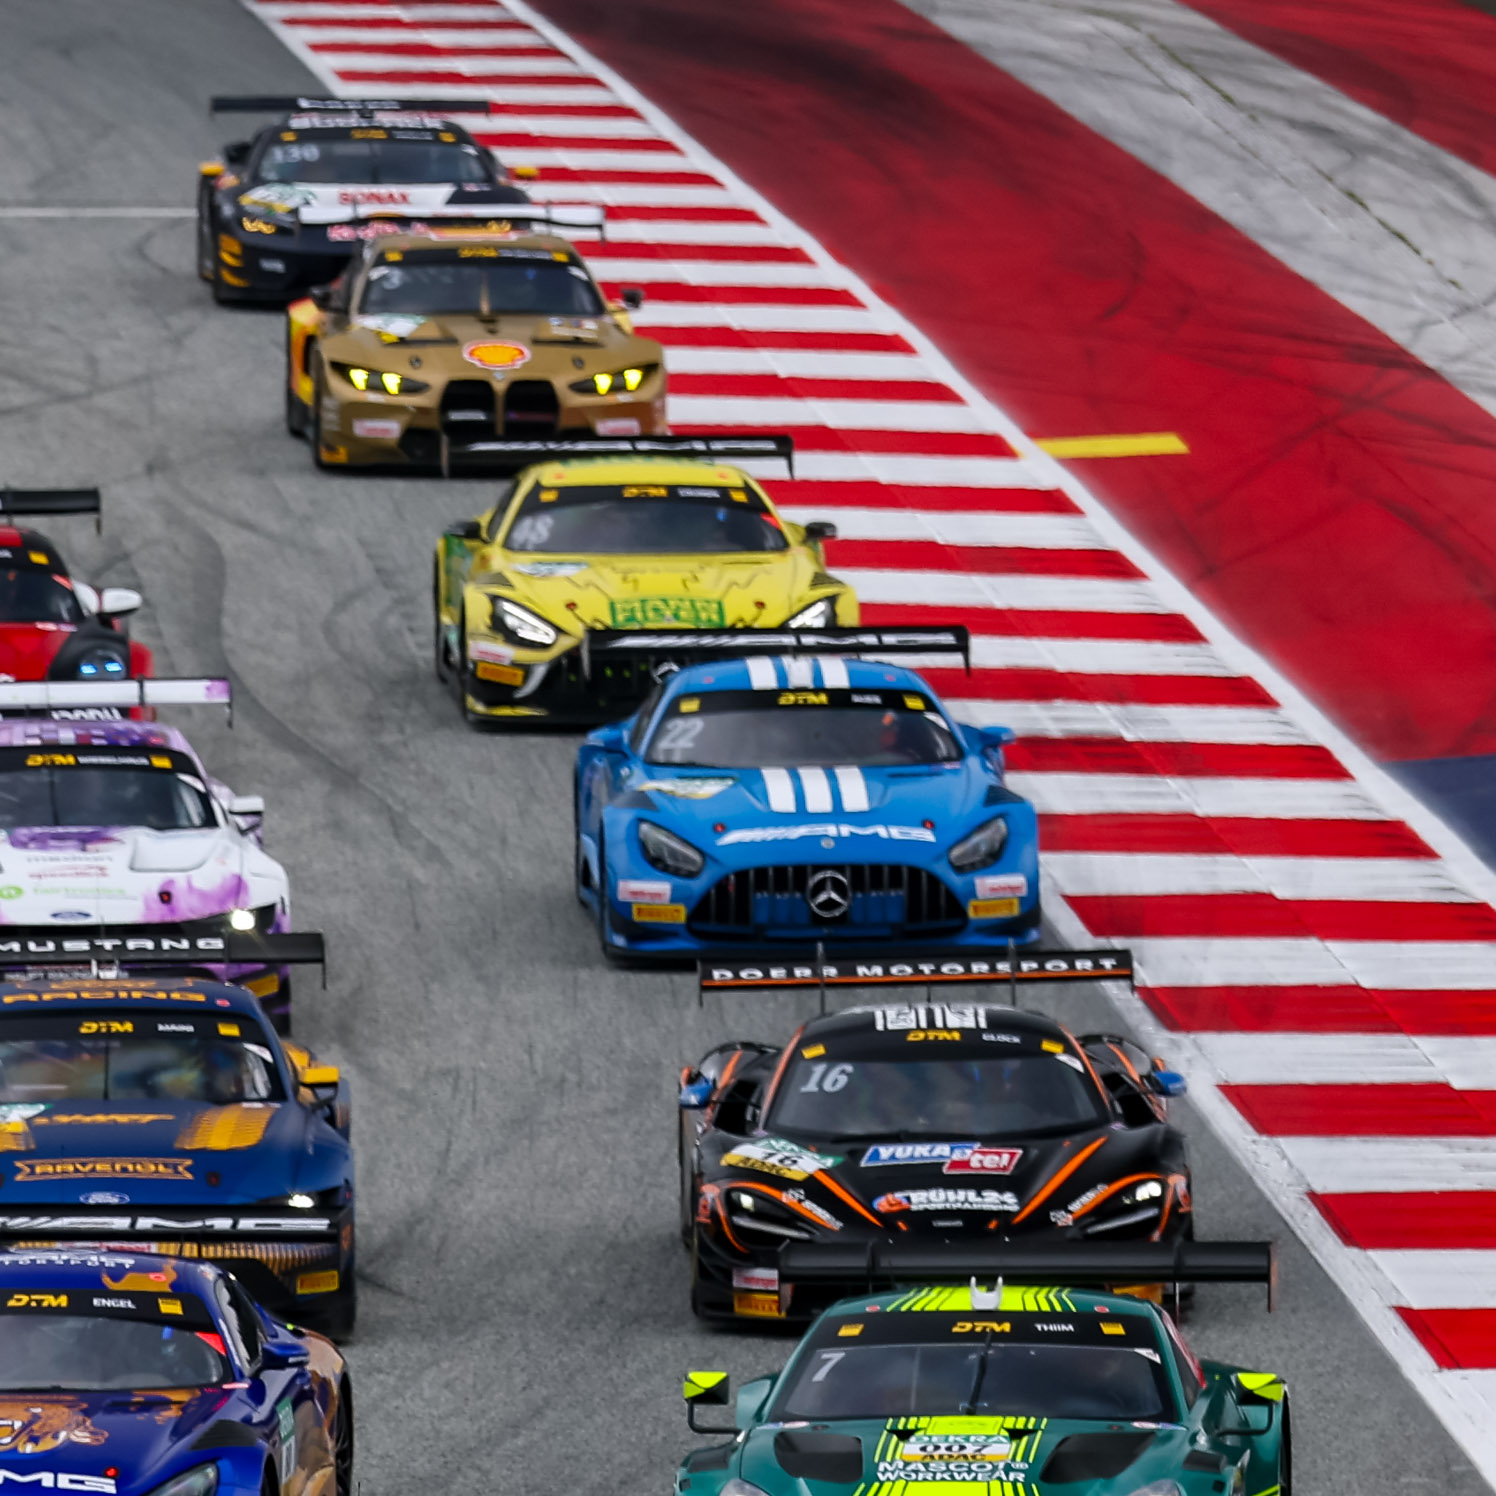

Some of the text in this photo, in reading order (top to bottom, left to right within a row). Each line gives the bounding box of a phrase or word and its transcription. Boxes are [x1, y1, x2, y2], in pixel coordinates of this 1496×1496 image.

[657, 719, 704, 749] 22
[26, 754, 75, 767] DTM
[712, 958, 1118, 982] DOERR MOTORSPORT
[79, 1021, 134, 1034] DTM
[906, 1031, 961, 1041] DTM
[800, 1063, 854, 1093] 16
[34, 1162, 172, 1176] RAVENOL
[52, 1216, 330, 1231] AMG
[6, 1294, 69, 1308] DTM
[93, 1297, 136, 1309] ENGEL
[951, 1321, 1011, 1334] DTM
[1034, 1322, 1074, 1333] THIIM
[811, 1352, 846, 1383] 7
[909, 1434, 1012, 1443] DEKRA
[918, 1442, 994, 1454] 007
[919, 1452, 988, 1462] ADAC
[876, 1471, 1026, 1482] WORKWEAR
